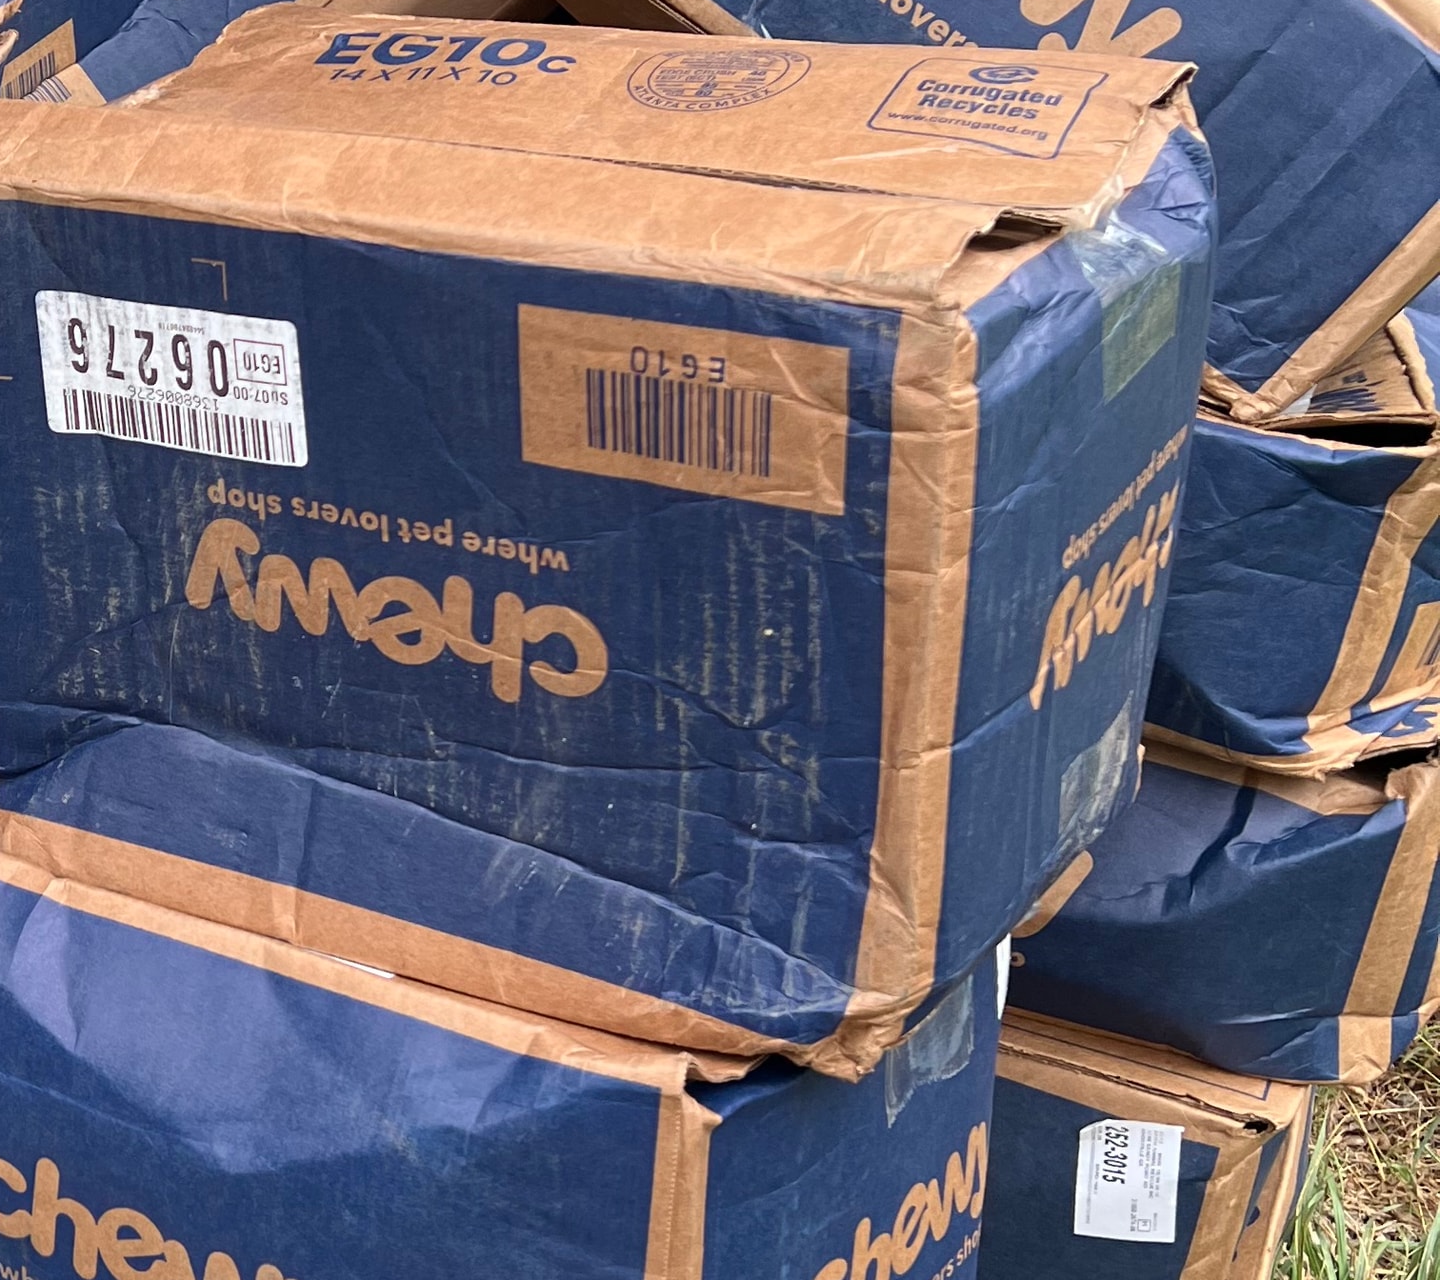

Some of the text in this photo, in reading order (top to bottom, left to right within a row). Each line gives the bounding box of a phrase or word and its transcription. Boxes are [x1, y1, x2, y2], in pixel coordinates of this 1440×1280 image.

[477, 69, 518, 85] 10
[633, 84, 680, 109] ATLANTA
[685, 87, 774, 110] COMPLEX
[916, 78, 1063, 107] Corrugated
[917, 94, 1040, 120] Recycles
[887, 111, 1049, 141] www.corrugated.org
[67, 317, 229, 398] 06276
[243, 351, 280, 375] EG10
[630, 344, 726, 384] EG10
[207, 477, 569, 575] where pet lovers shop
[184, 517, 609, 703] chewy
[1102, 1125, 1129, 1185] 252-3015
